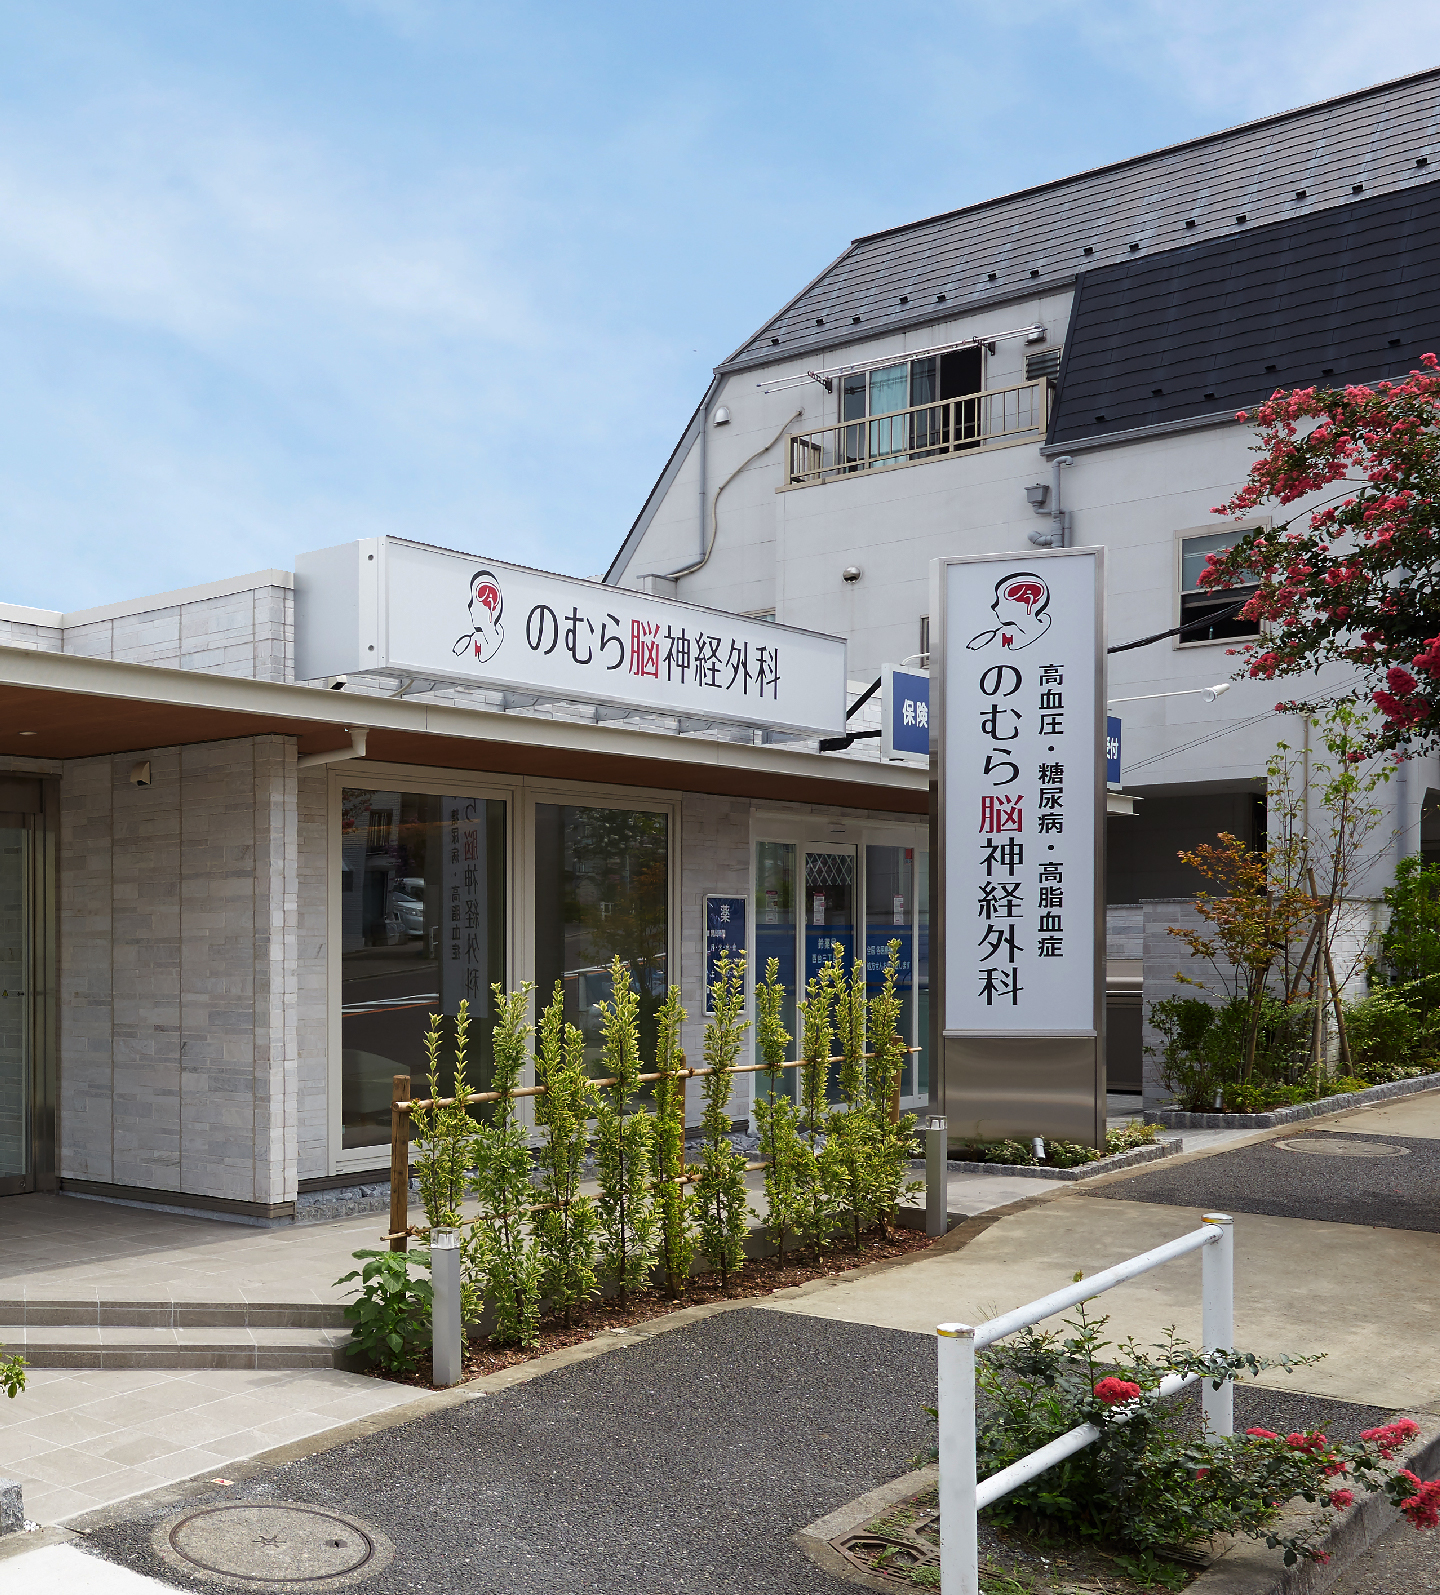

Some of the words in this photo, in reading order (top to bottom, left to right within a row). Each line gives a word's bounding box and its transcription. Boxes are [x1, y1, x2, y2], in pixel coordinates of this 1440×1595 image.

[526, 603, 782, 701] のむら脳神経外科
[902, 698, 929, 729] 保険
[977, 664, 1025, 1006] のむら脳神経外科
[1036, 663, 1065, 958] 高血圧・糖尿病・高脂血症
